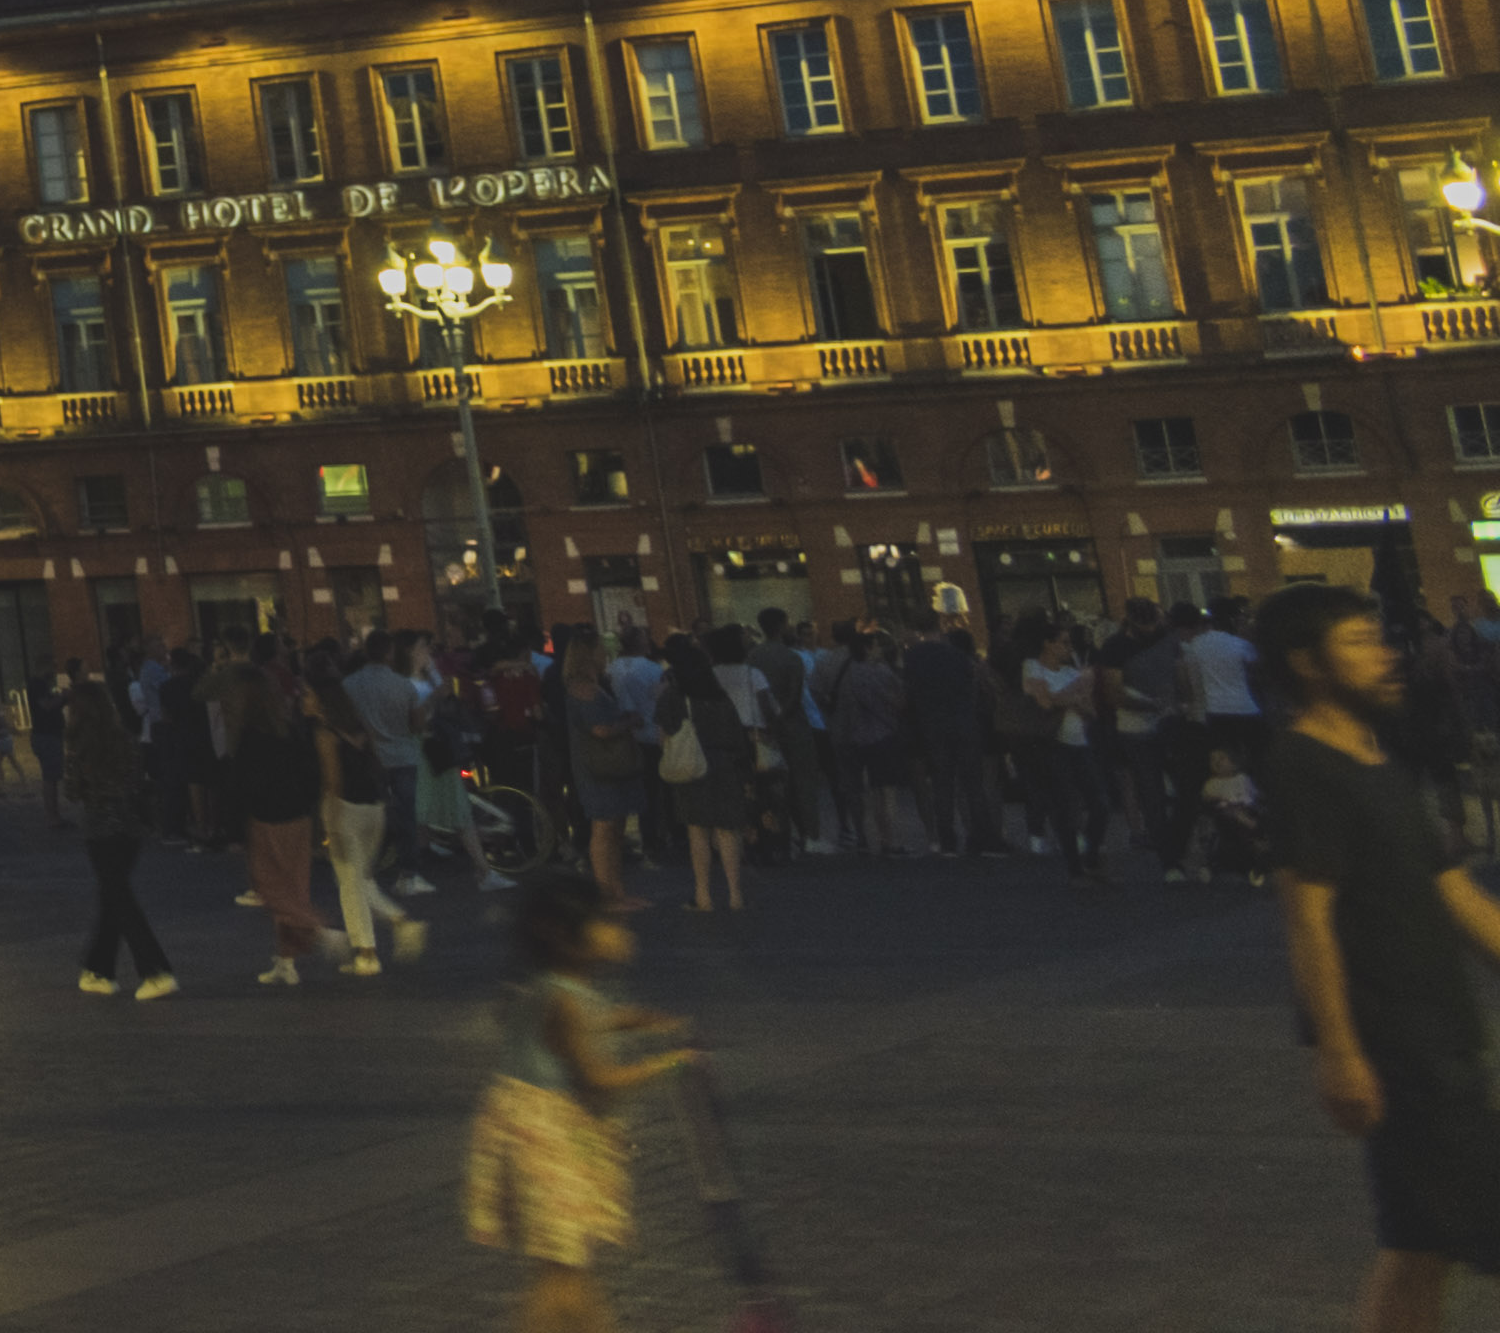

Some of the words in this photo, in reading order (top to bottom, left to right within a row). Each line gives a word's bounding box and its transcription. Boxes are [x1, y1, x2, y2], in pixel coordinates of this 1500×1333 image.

[20, 204, 152, 245] GRAND
[181, 190, 313, 230] HOTEL
[342, 181, 399, 218] DE
